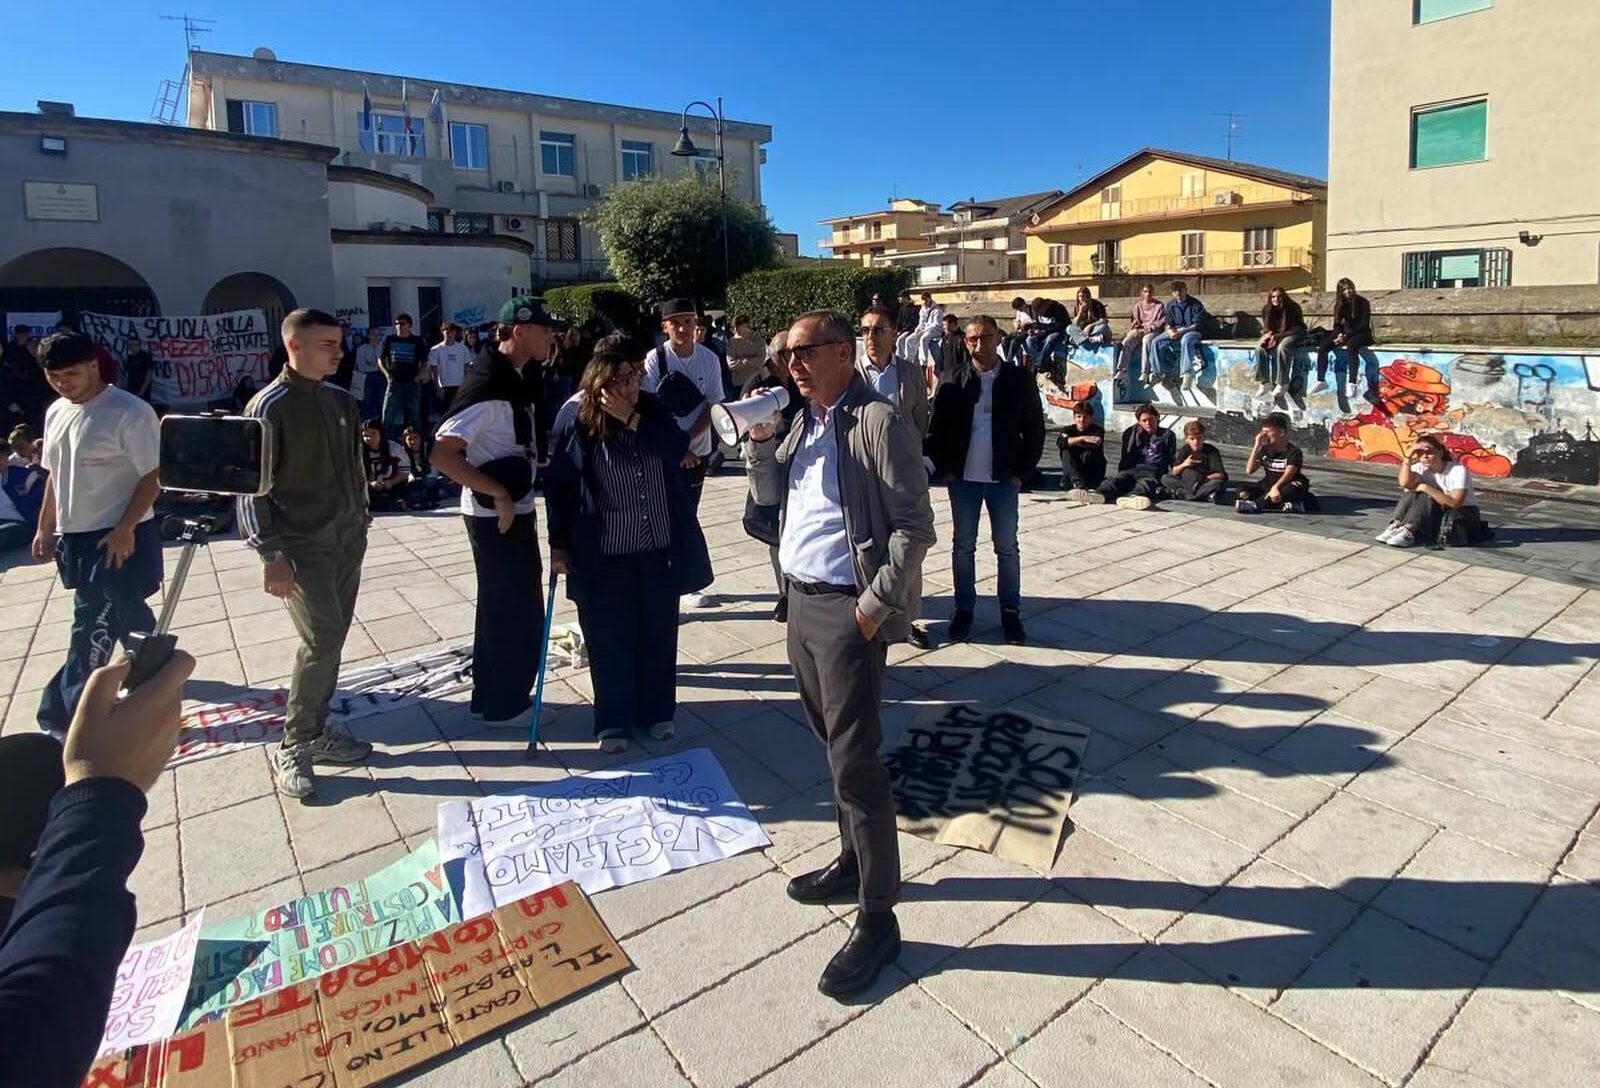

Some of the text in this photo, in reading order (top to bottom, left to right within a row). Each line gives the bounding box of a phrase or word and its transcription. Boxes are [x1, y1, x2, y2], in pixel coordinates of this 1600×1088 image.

[82, 314, 115, 334] PER
[119, 319, 139, 337] LA
[144, 318, 210, 340] SCUOLA
[174, 352, 272, 397] DISPREZZO
[425, 864, 443, 890] A
[434, 892, 450, 923] A
[517, 886, 568, 918] LA
[361, 906, 436, 955] PEZZI
[472, 921, 561, 967] CARTA
[192, 937, 280, 984] NOSTR
[230, 917, 496, 1027] COMPRATE
[288, 940, 357, 982] COME
[552, 943, 612, 971] IL
[313, 1031, 352, 1058] LA
